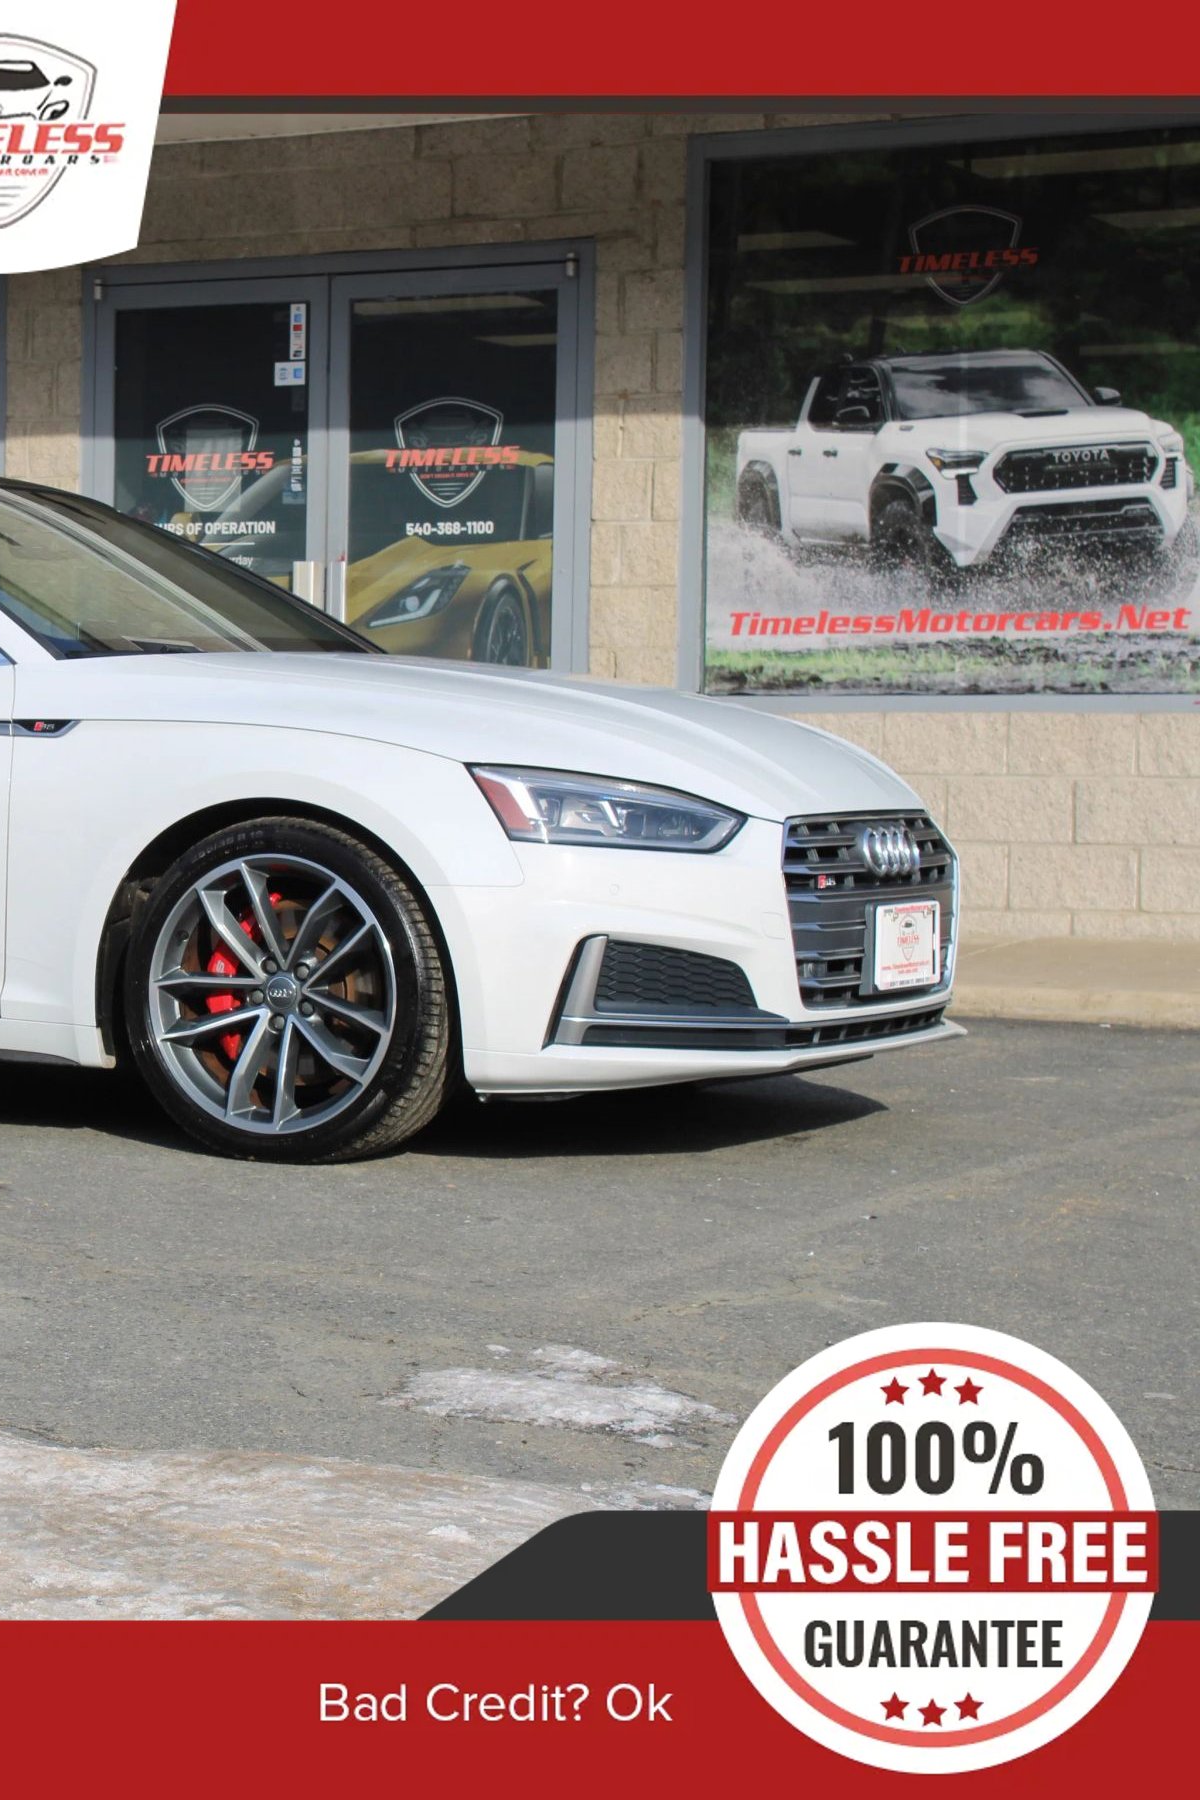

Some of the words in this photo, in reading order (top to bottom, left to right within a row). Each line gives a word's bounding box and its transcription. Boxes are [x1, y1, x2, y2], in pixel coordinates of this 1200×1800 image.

[897, 246, 1039, 272] TIMELESS
[145, 451, 275, 473] TIMELESS
[384, 445, 520, 468] TIMELESS
[1053, 448, 1110, 463] TOYOTA
[186, 521, 203, 536] OF
[205, 520, 276, 535] OPERATION
[405, 520, 495, 536] 540-368-1100
[729, 603, 1191, 637] TimelessMotorcars.Net
